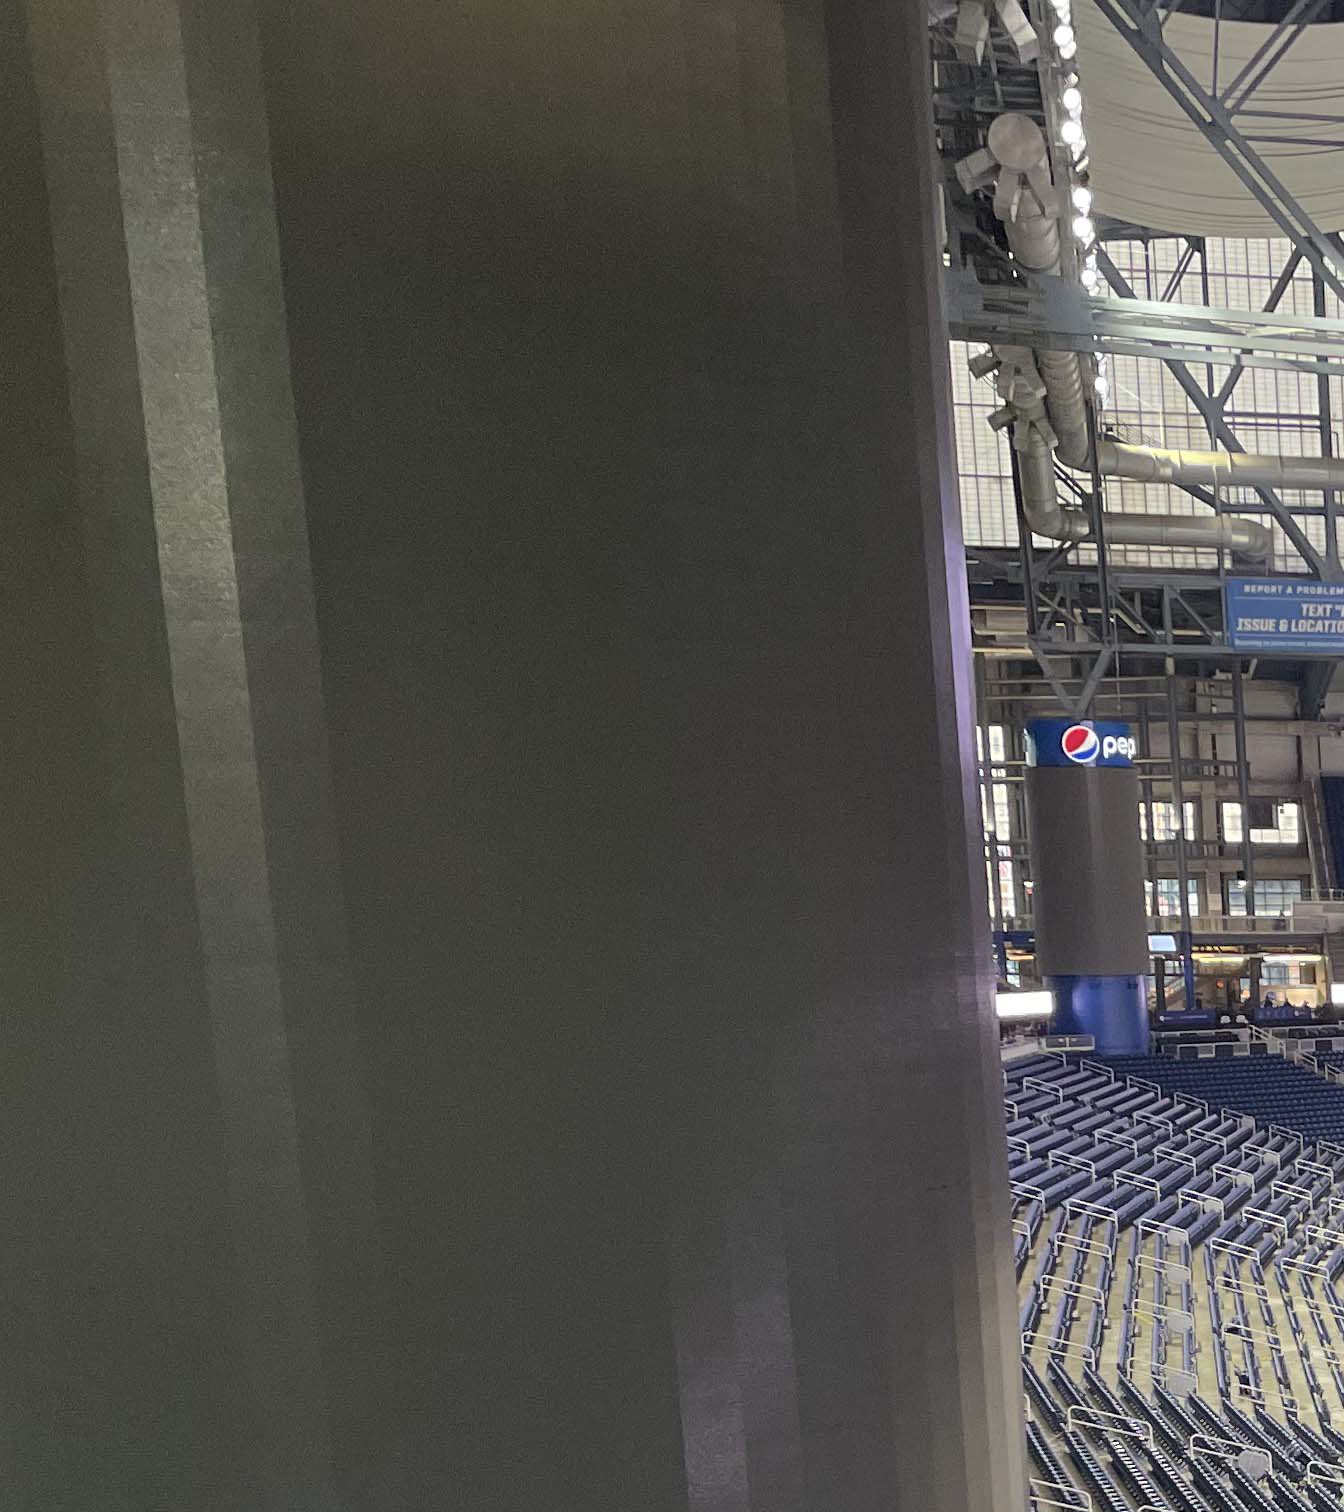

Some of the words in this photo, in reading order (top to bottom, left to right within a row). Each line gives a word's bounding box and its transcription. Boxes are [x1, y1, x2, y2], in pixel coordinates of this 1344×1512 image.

[1243, 584, 1283, 594] REPORT
[1286, 586, 1294, 595] A
[1296, 586, 1344, 596] PROBLEM
[1301, 602, 1332, 618] TEXT
[1236, 617, 1276, 633] ISSUE
[1278, 618, 1289, 633] &
